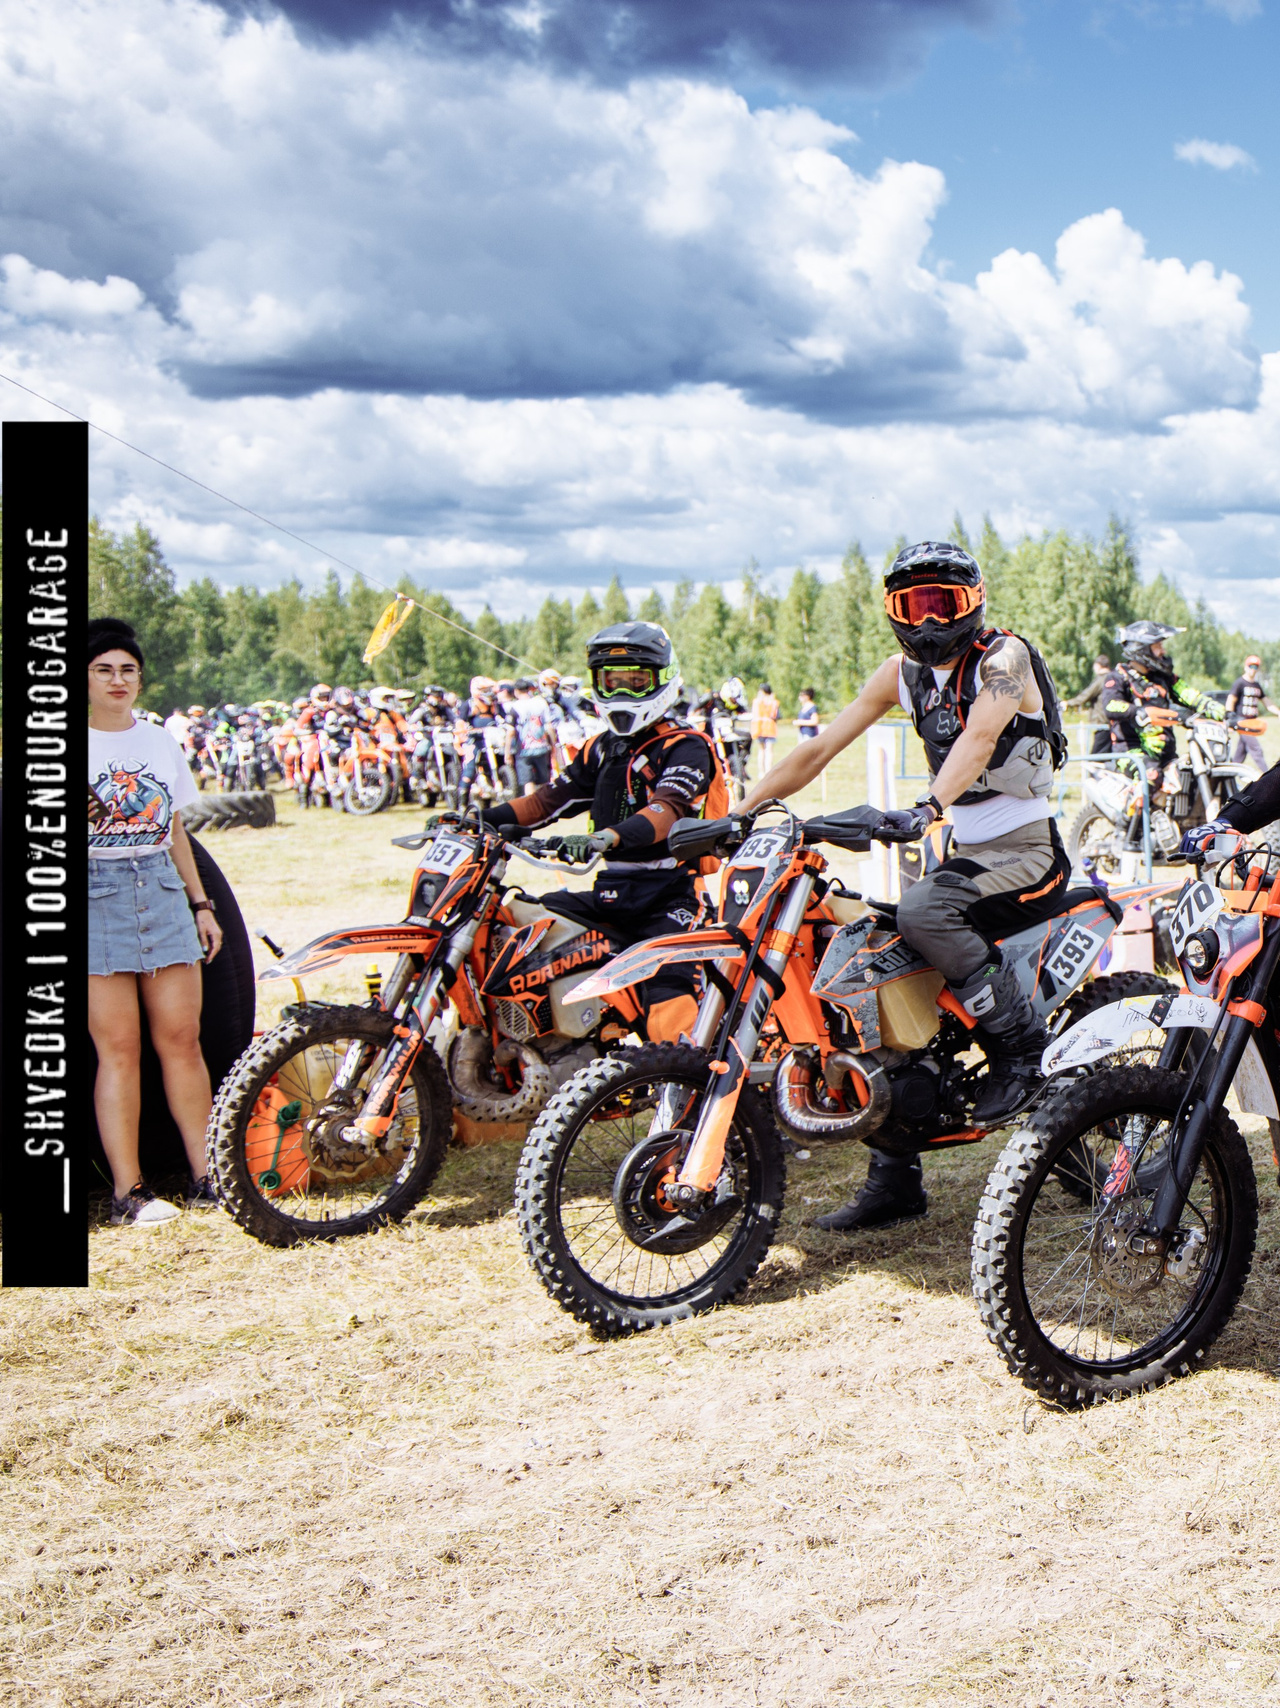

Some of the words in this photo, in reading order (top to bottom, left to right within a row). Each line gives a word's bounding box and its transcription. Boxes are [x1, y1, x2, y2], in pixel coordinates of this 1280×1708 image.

[1171, 883, 1215, 945] 370
[509, 938, 611, 998] ADRENALIN
[1051, 929, 1094, 980] 393
